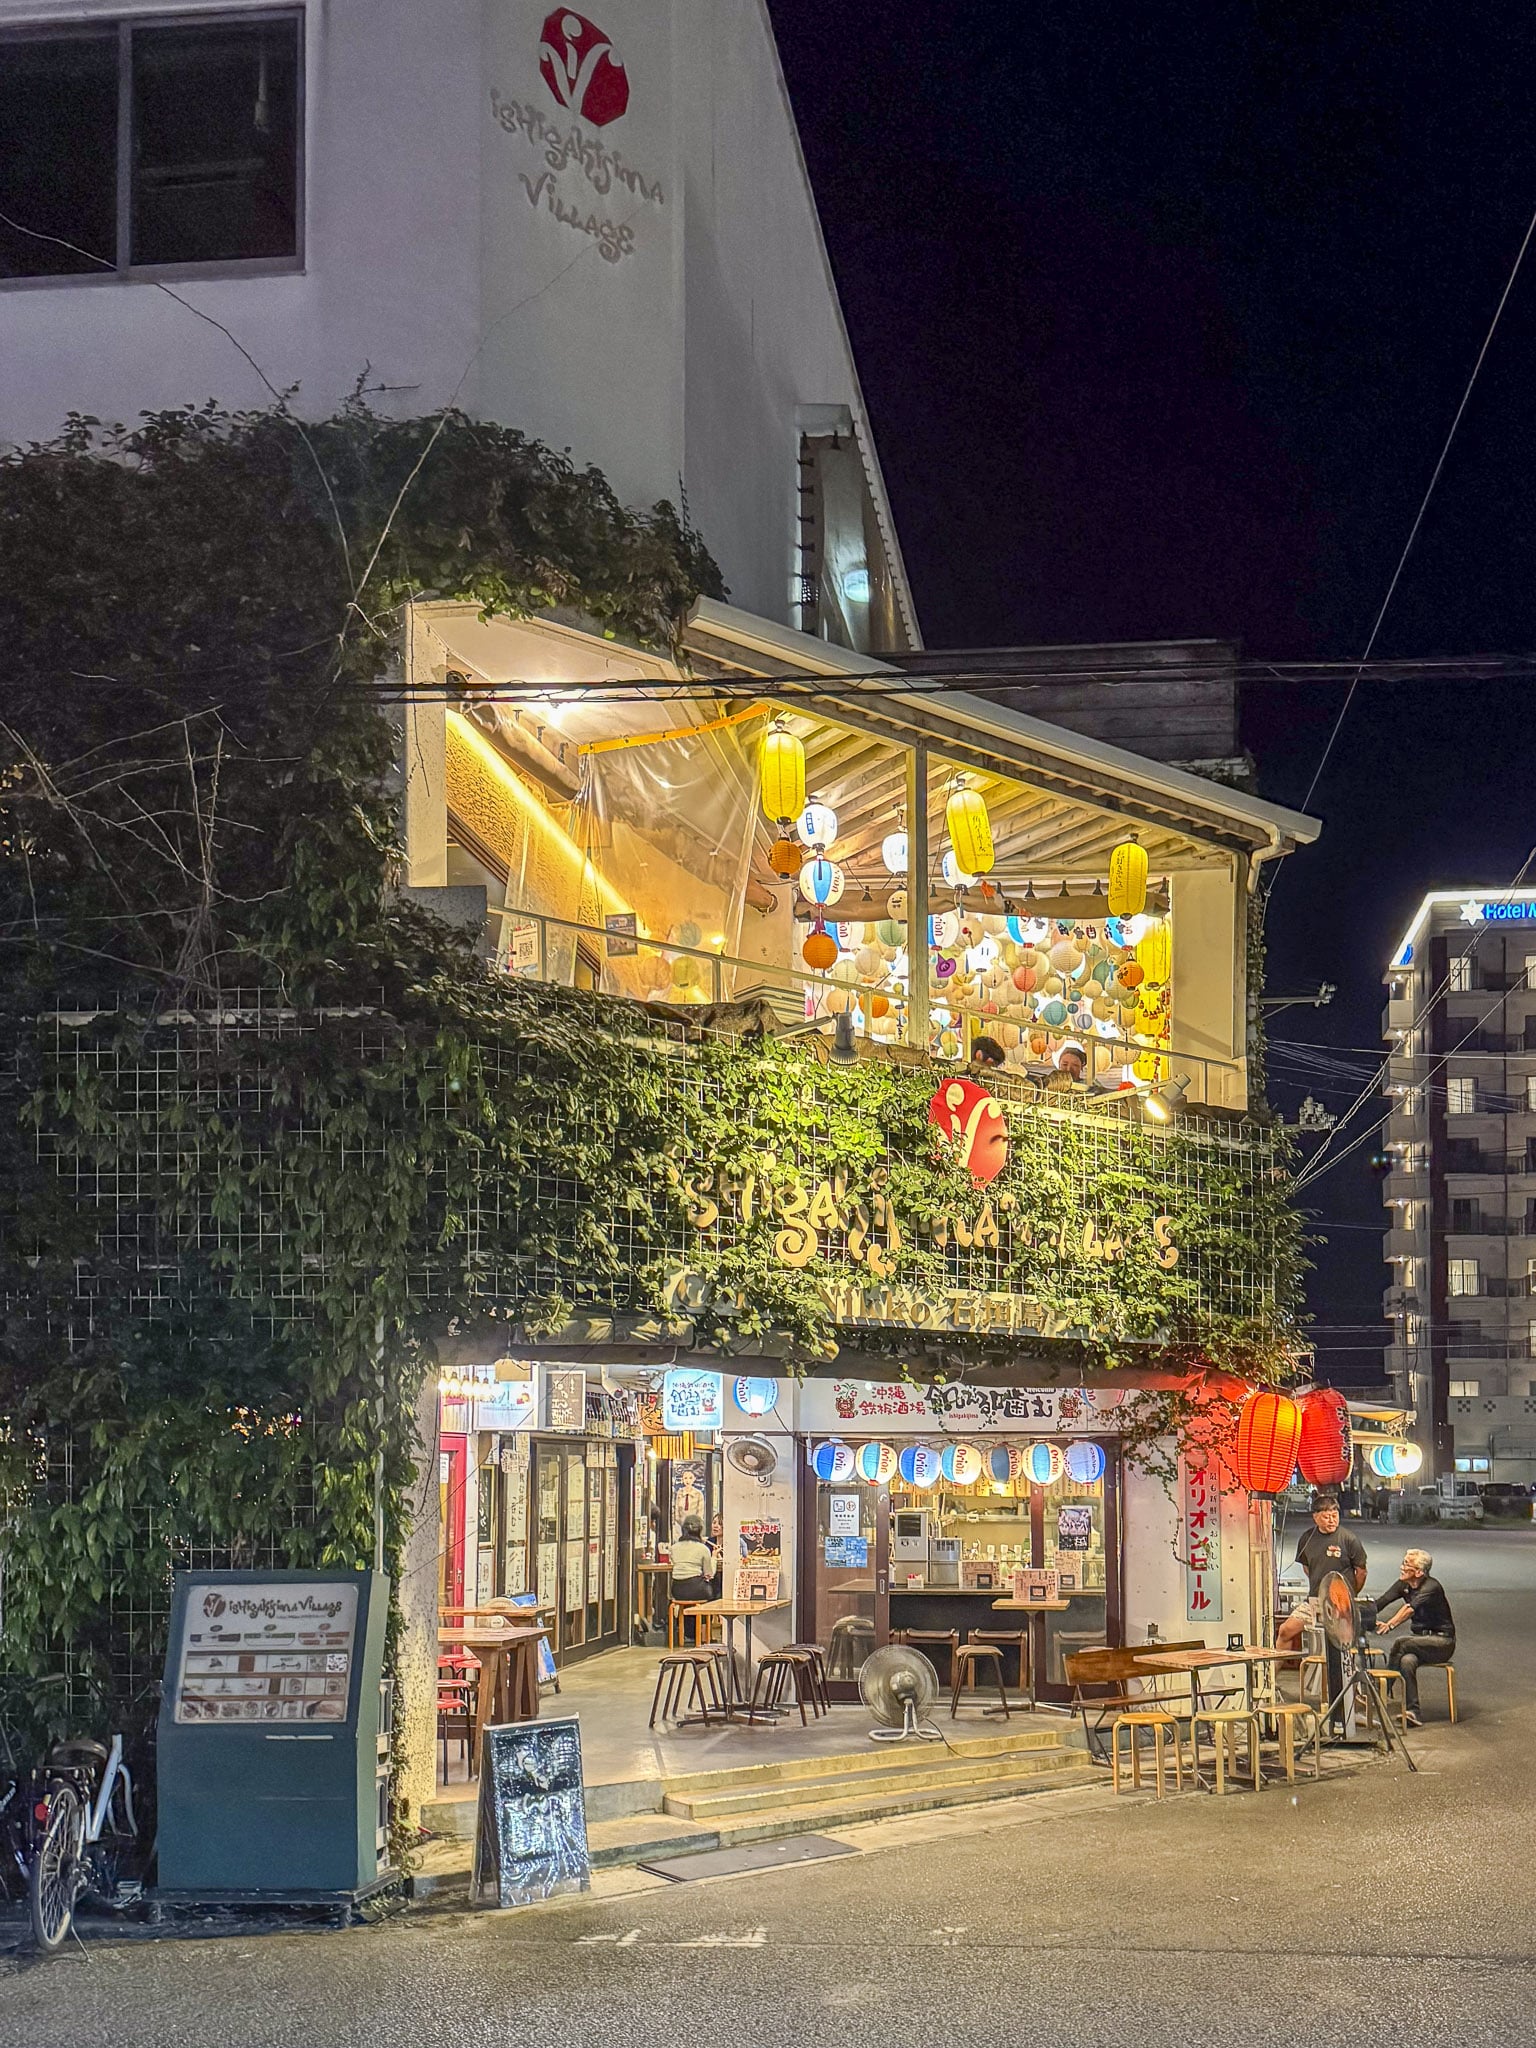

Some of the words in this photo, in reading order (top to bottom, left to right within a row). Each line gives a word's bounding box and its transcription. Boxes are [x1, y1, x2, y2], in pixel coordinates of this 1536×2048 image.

[1486, 902, 1525, 919] Hotel
[871, 1385, 906, 1400] 沖縄
[859, 1401, 926, 1416] 鉄板酒場
[880, 1447, 892, 1474] Orion
[915, 1452, 929, 1479] Orion
[956, 1448, 969, 1475] Orion
[1008, 1449, 1021, 1476] Orion
[1050, 1449, 1062, 1476] Orion
[1189, 1470, 1211, 1611] オリオンビール
